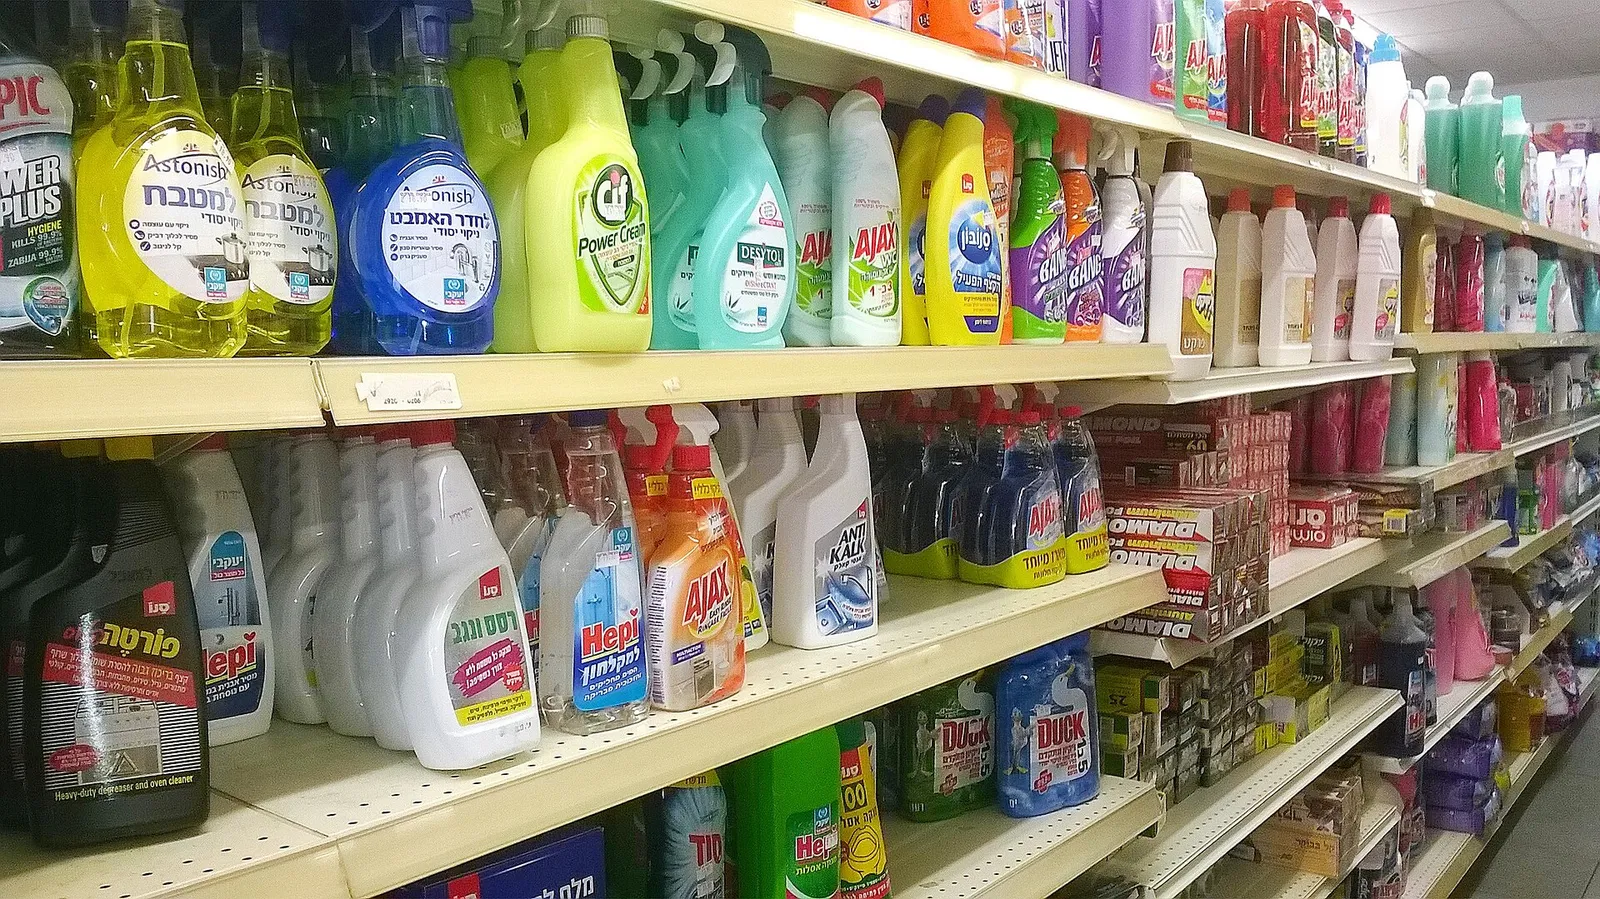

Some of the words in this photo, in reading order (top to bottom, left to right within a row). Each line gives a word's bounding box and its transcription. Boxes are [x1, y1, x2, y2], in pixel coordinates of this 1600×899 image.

[1151, 24, 1175, 61] AJA
[1207, 55, 1227, 88] AJA
[142, 154, 228, 180] Astonish
[242, 173, 317, 198] Aston
[142, 184, 237, 213] למטבח
[27, 220, 62, 237] HYGIENE
[201, 212, 227, 225] יסודי
[390, 212, 453, 226] האמבט
[455, 213, 490, 229] לחדר
[289, 224, 314, 237] יסודי
[433, 228, 458, 237] יסודי
[462, 228, 480, 240] ניקוי
[578, 231, 619, 258] Power
[619, 222, 647, 244] Cream
[11, 236, 36, 249] KILLS
[801, 232, 832, 268] AJA
[853, 221, 896, 264] AJAX
[8, 253, 37, 268] ZABIJA
[1040, 247, 1067, 283] BAN
[956, 270, 983, 289] הפעיל
[1069, 254, 1101, 289] BANG
[1106, 506, 1124, 516] FO
[839, 522, 866, 546] ANTI
[1108, 518, 1198, 538] DIAMO
[830, 538, 865, 565] KALK
[1108, 538, 1125, 547] FO
[212, 556, 244, 571] יעקבי
[1023, 552, 1050, 571] מיוחד
[1110, 550, 1196, 571] DIAMO
[482, 585, 499, 597] סנו
[683, 560, 730, 622] AJAX
[148, 601, 171, 615] סנו
[709, 605, 720, 619] EASY
[450, 616, 483, 645] ונגב
[484, 610, 518, 636] רסס
[581, 607, 640, 657] Hepi
[1107, 617, 1193, 638] DIAMO
[92, 655, 108, 666] שומ
[204, 631, 257, 683] epi
[217, 679, 240, 693] אבנית
[240, 672, 258, 685] מסיר
[942, 715, 990, 753] DUCK
[1037, 711, 1087, 750] DUCK
[54, 787, 97, 801] Heavy-duty
[98, 783, 134, 796] degreaser
[135, 780, 149, 791] and
[150, 779, 168, 789] oven
[168, 774, 194, 787] cleaner
[689, 833, 723, 867] סוד
[795, 833, 838, 862] Hep
